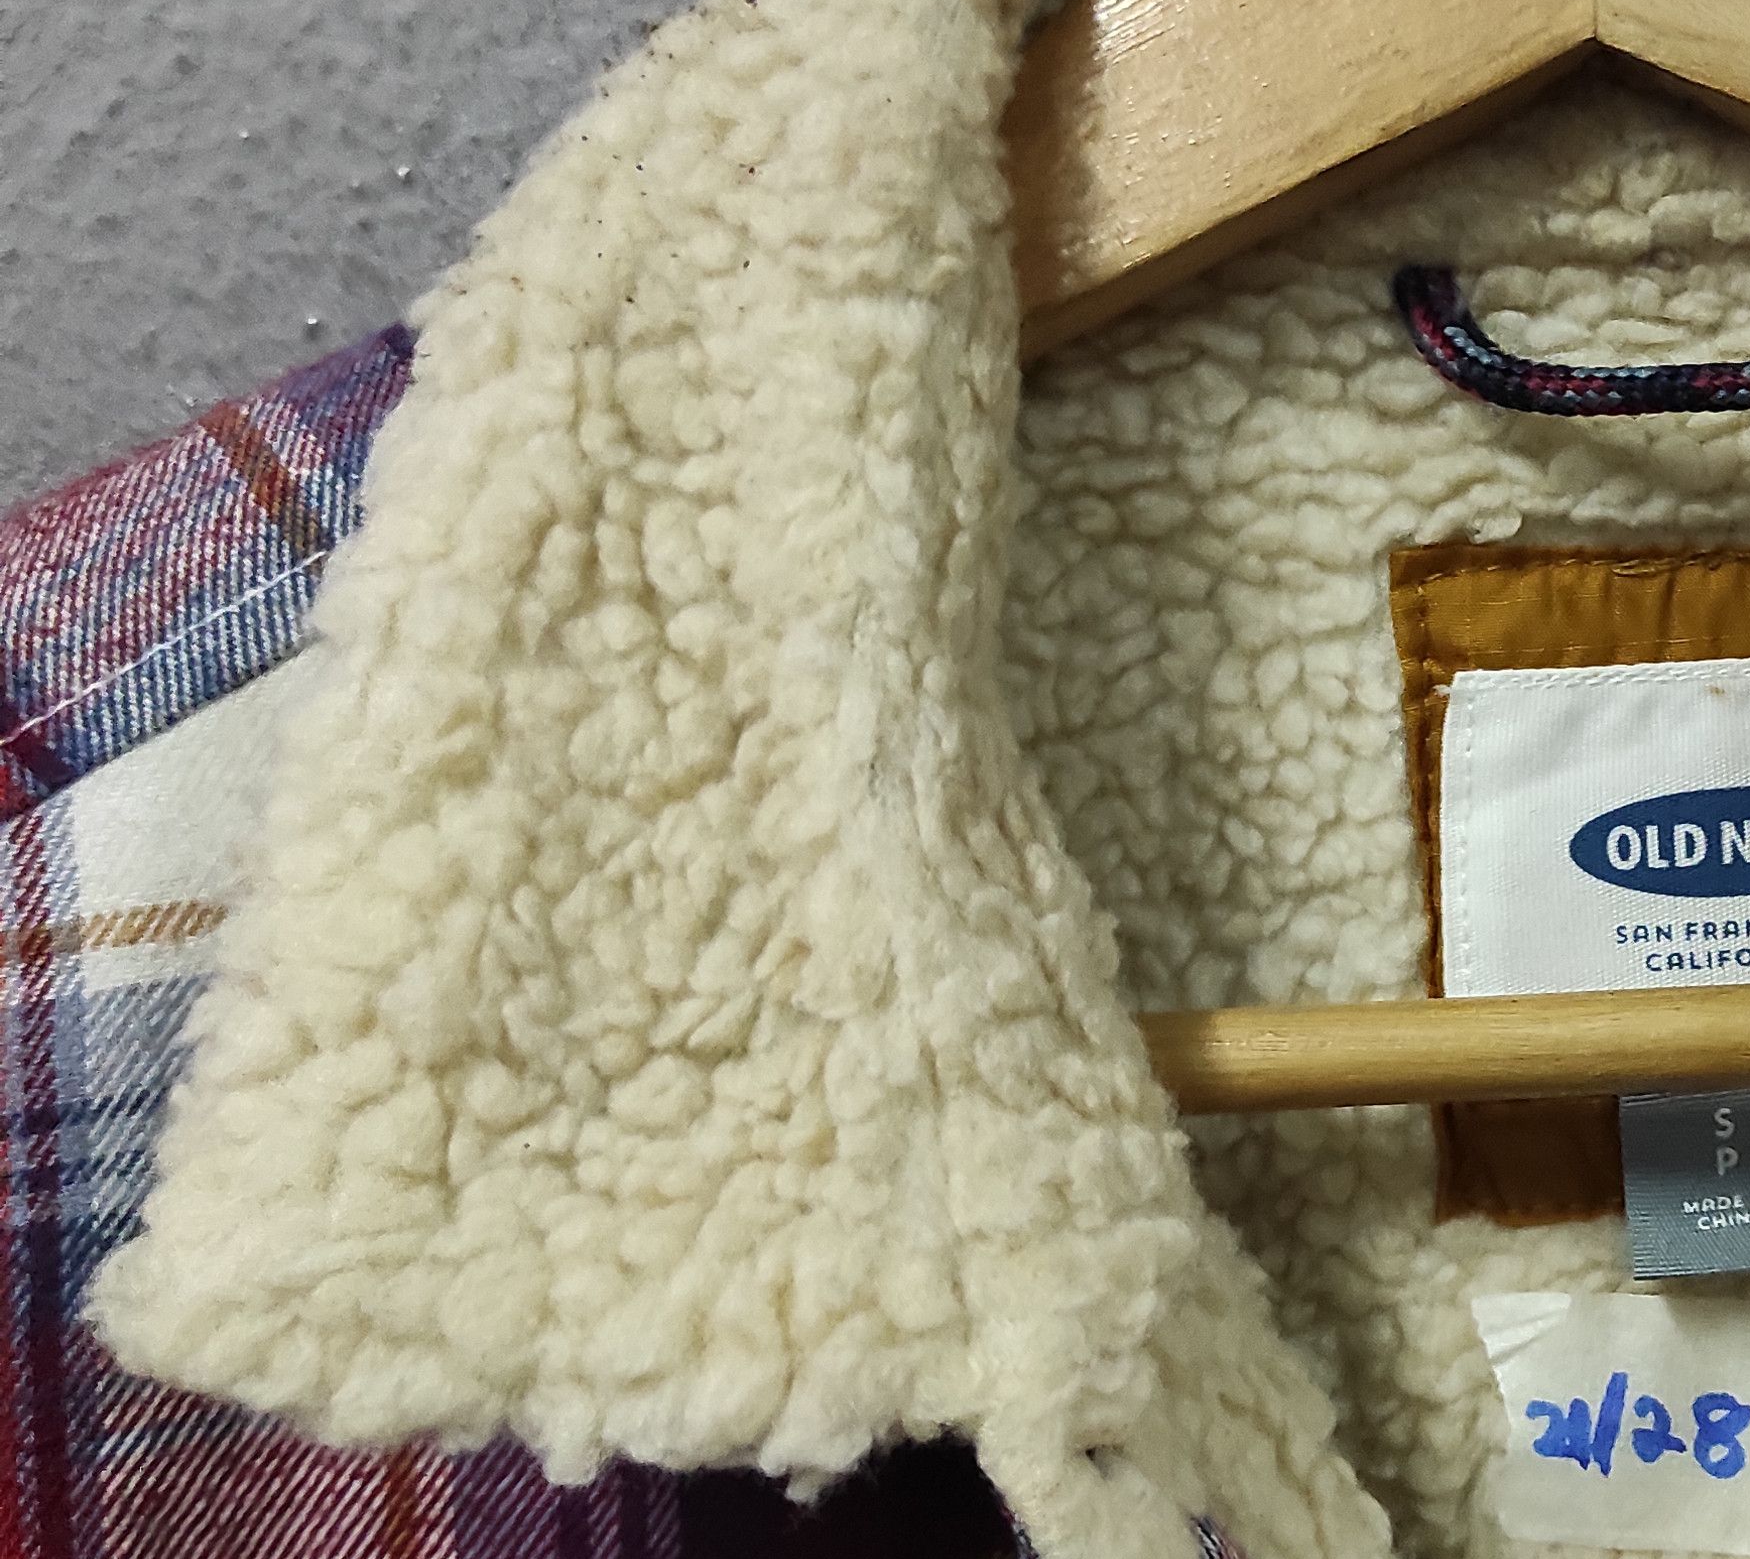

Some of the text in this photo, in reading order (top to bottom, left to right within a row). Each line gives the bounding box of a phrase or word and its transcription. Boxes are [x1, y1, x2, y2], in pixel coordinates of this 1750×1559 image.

[1605, 823, 1708, 871] OLD
[1616, 924, 1674, 945] SAN
[1714, 1107, 1735, 1139] S
[1716, 1146, 1739, 1176] P
[1683, 1195, 1745, 1215] MADE
